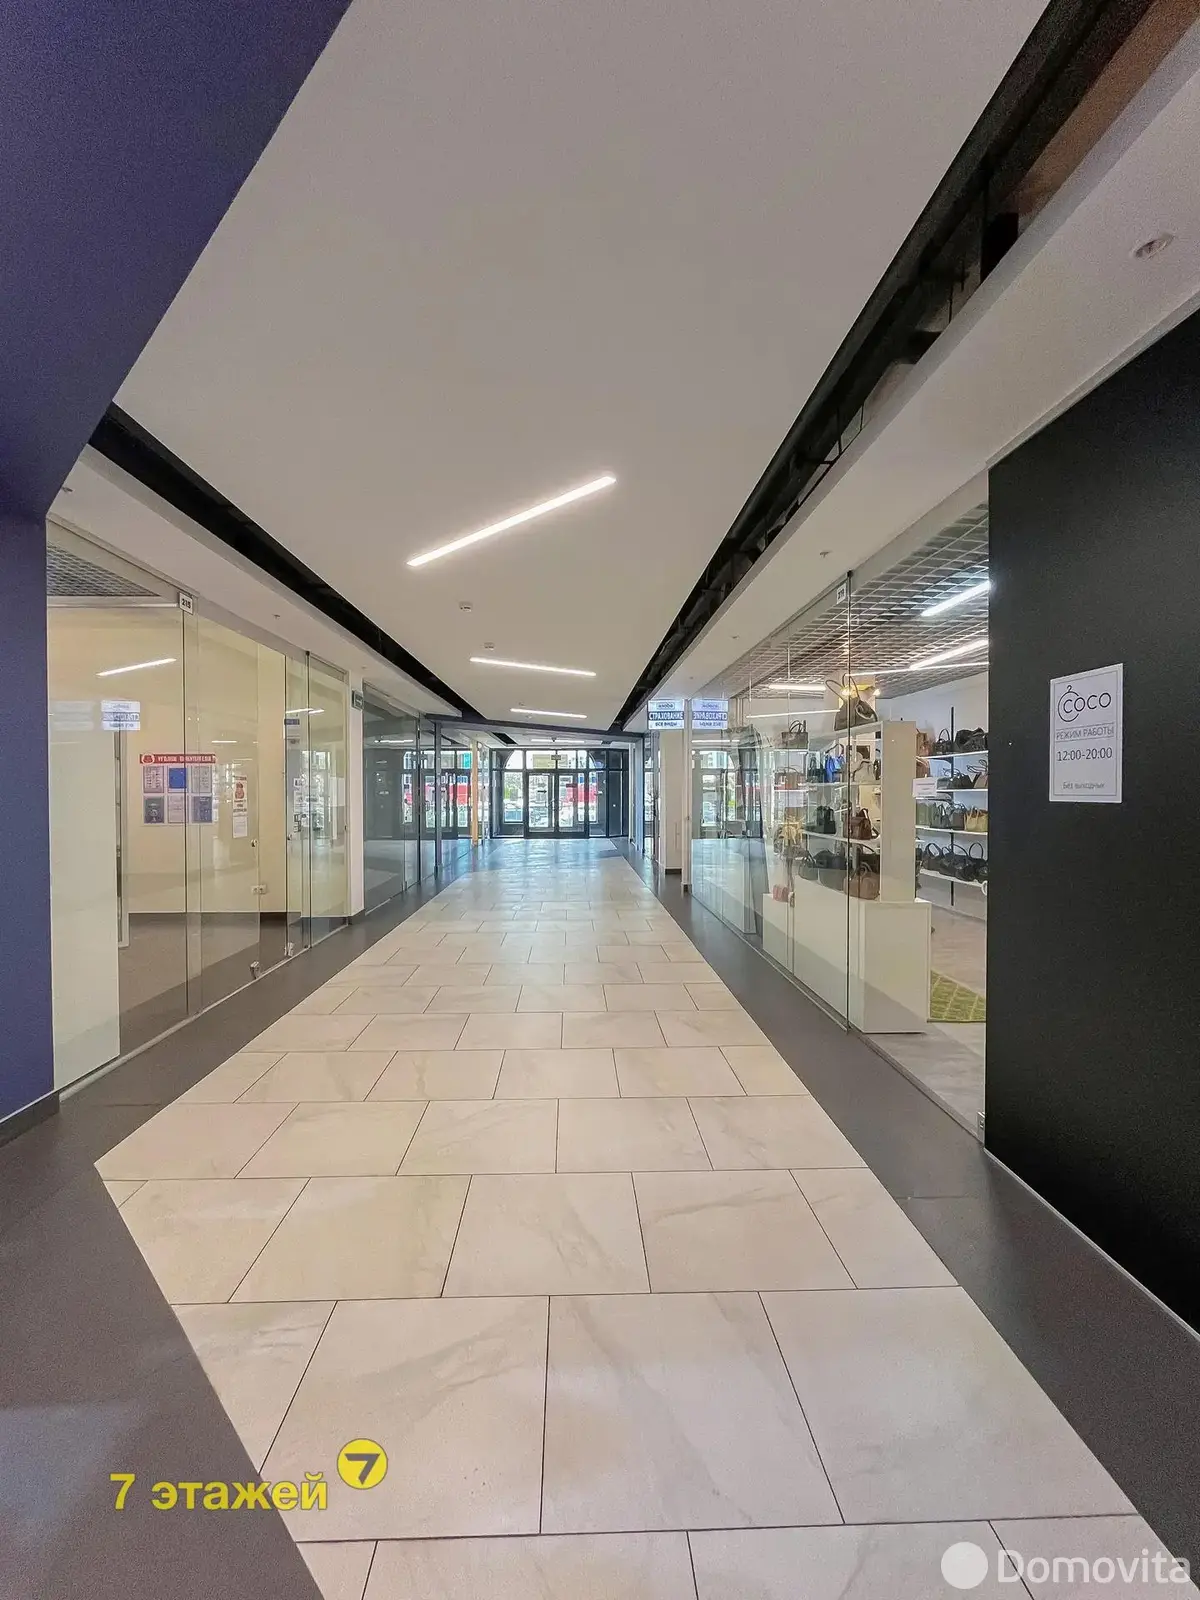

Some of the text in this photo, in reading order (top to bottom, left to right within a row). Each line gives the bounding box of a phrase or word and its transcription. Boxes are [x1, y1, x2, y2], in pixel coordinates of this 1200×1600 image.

[1056, 726, 1115, 741] РЕЖИМ РАБОТЫ
[1056, 747, 1113, 762] 12:00-20:00
